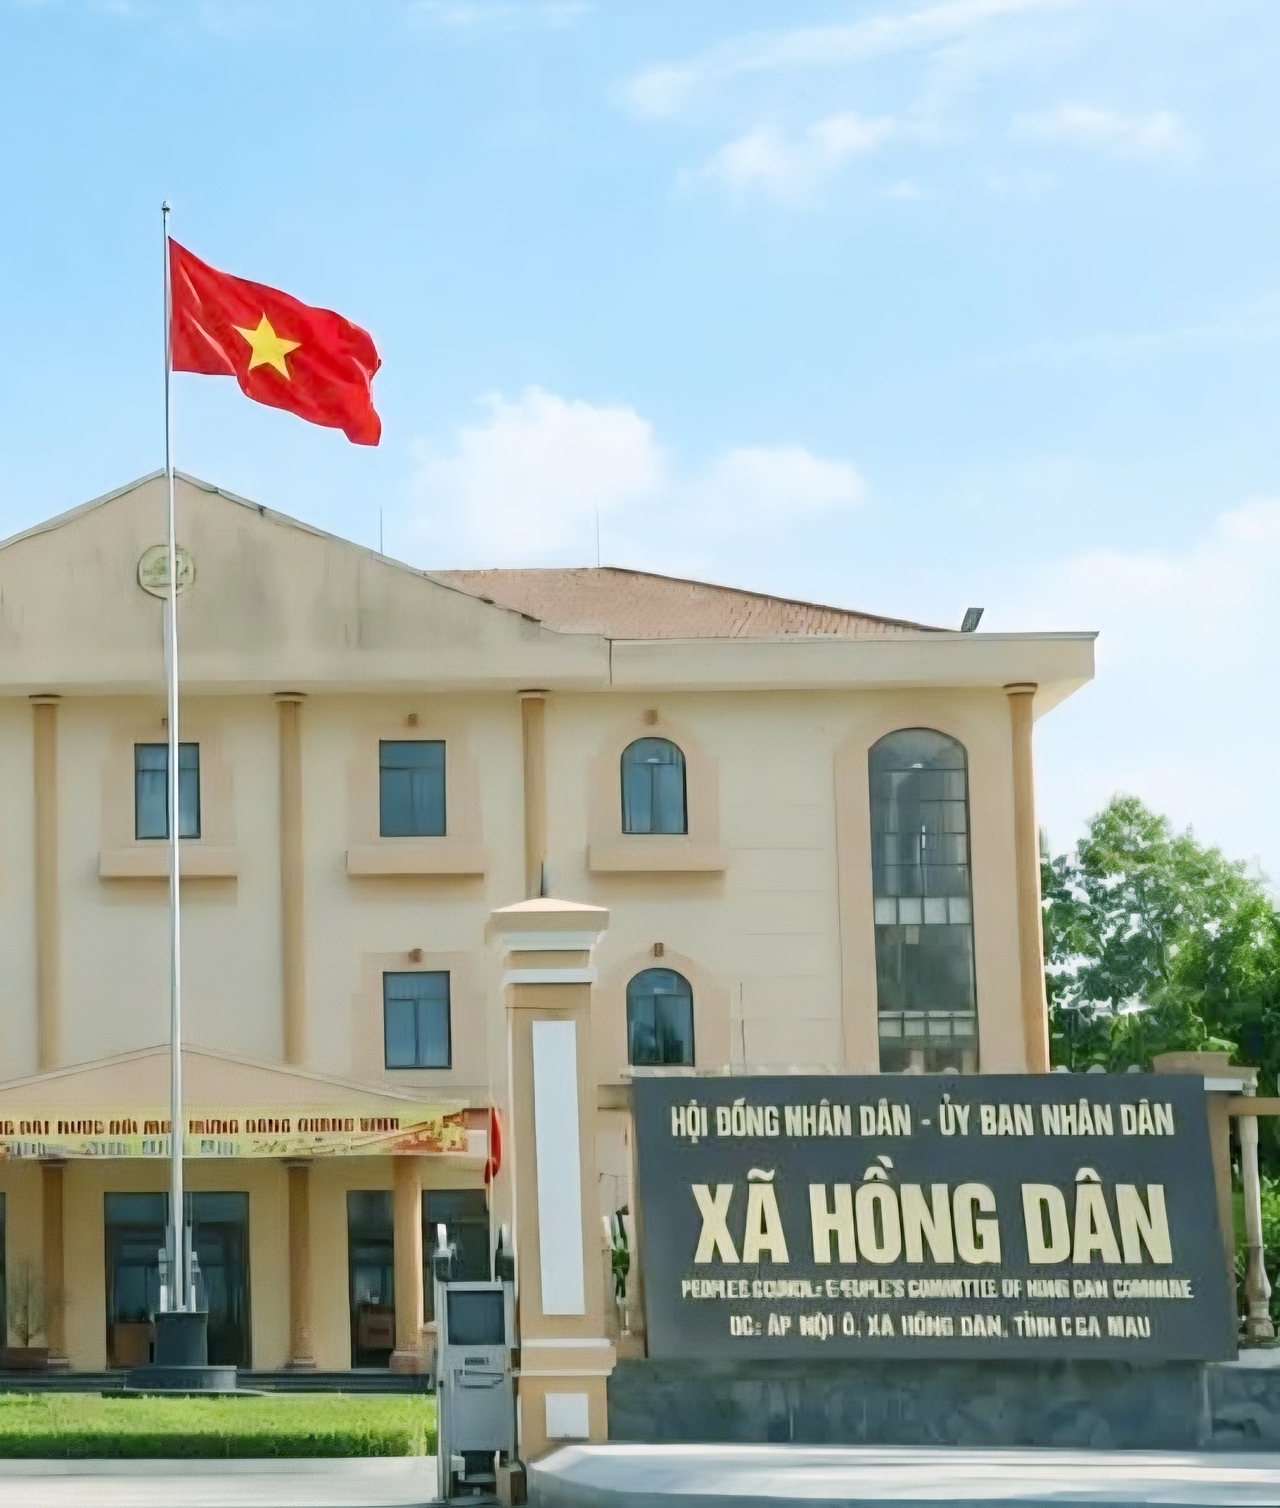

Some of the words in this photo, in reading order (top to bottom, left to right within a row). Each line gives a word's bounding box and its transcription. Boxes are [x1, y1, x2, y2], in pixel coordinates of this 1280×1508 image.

[671, 1098, 708, 1144] HỘI
[784, 1098, 852, 1137] NHÂN
[859, 1097, 912, 1137] DÂN
[980, 1103, 1034, 1136] BAN
[1041, 1098, 1114, 1136] NHÂN
[1119, 1098, 1175, 1136] DÂN
[691, 1168, 790, 1264] XÃ
[808, 1155, 1002, 1265] HỒNG
[1021, 1167, 1173, 1264] DÂN
